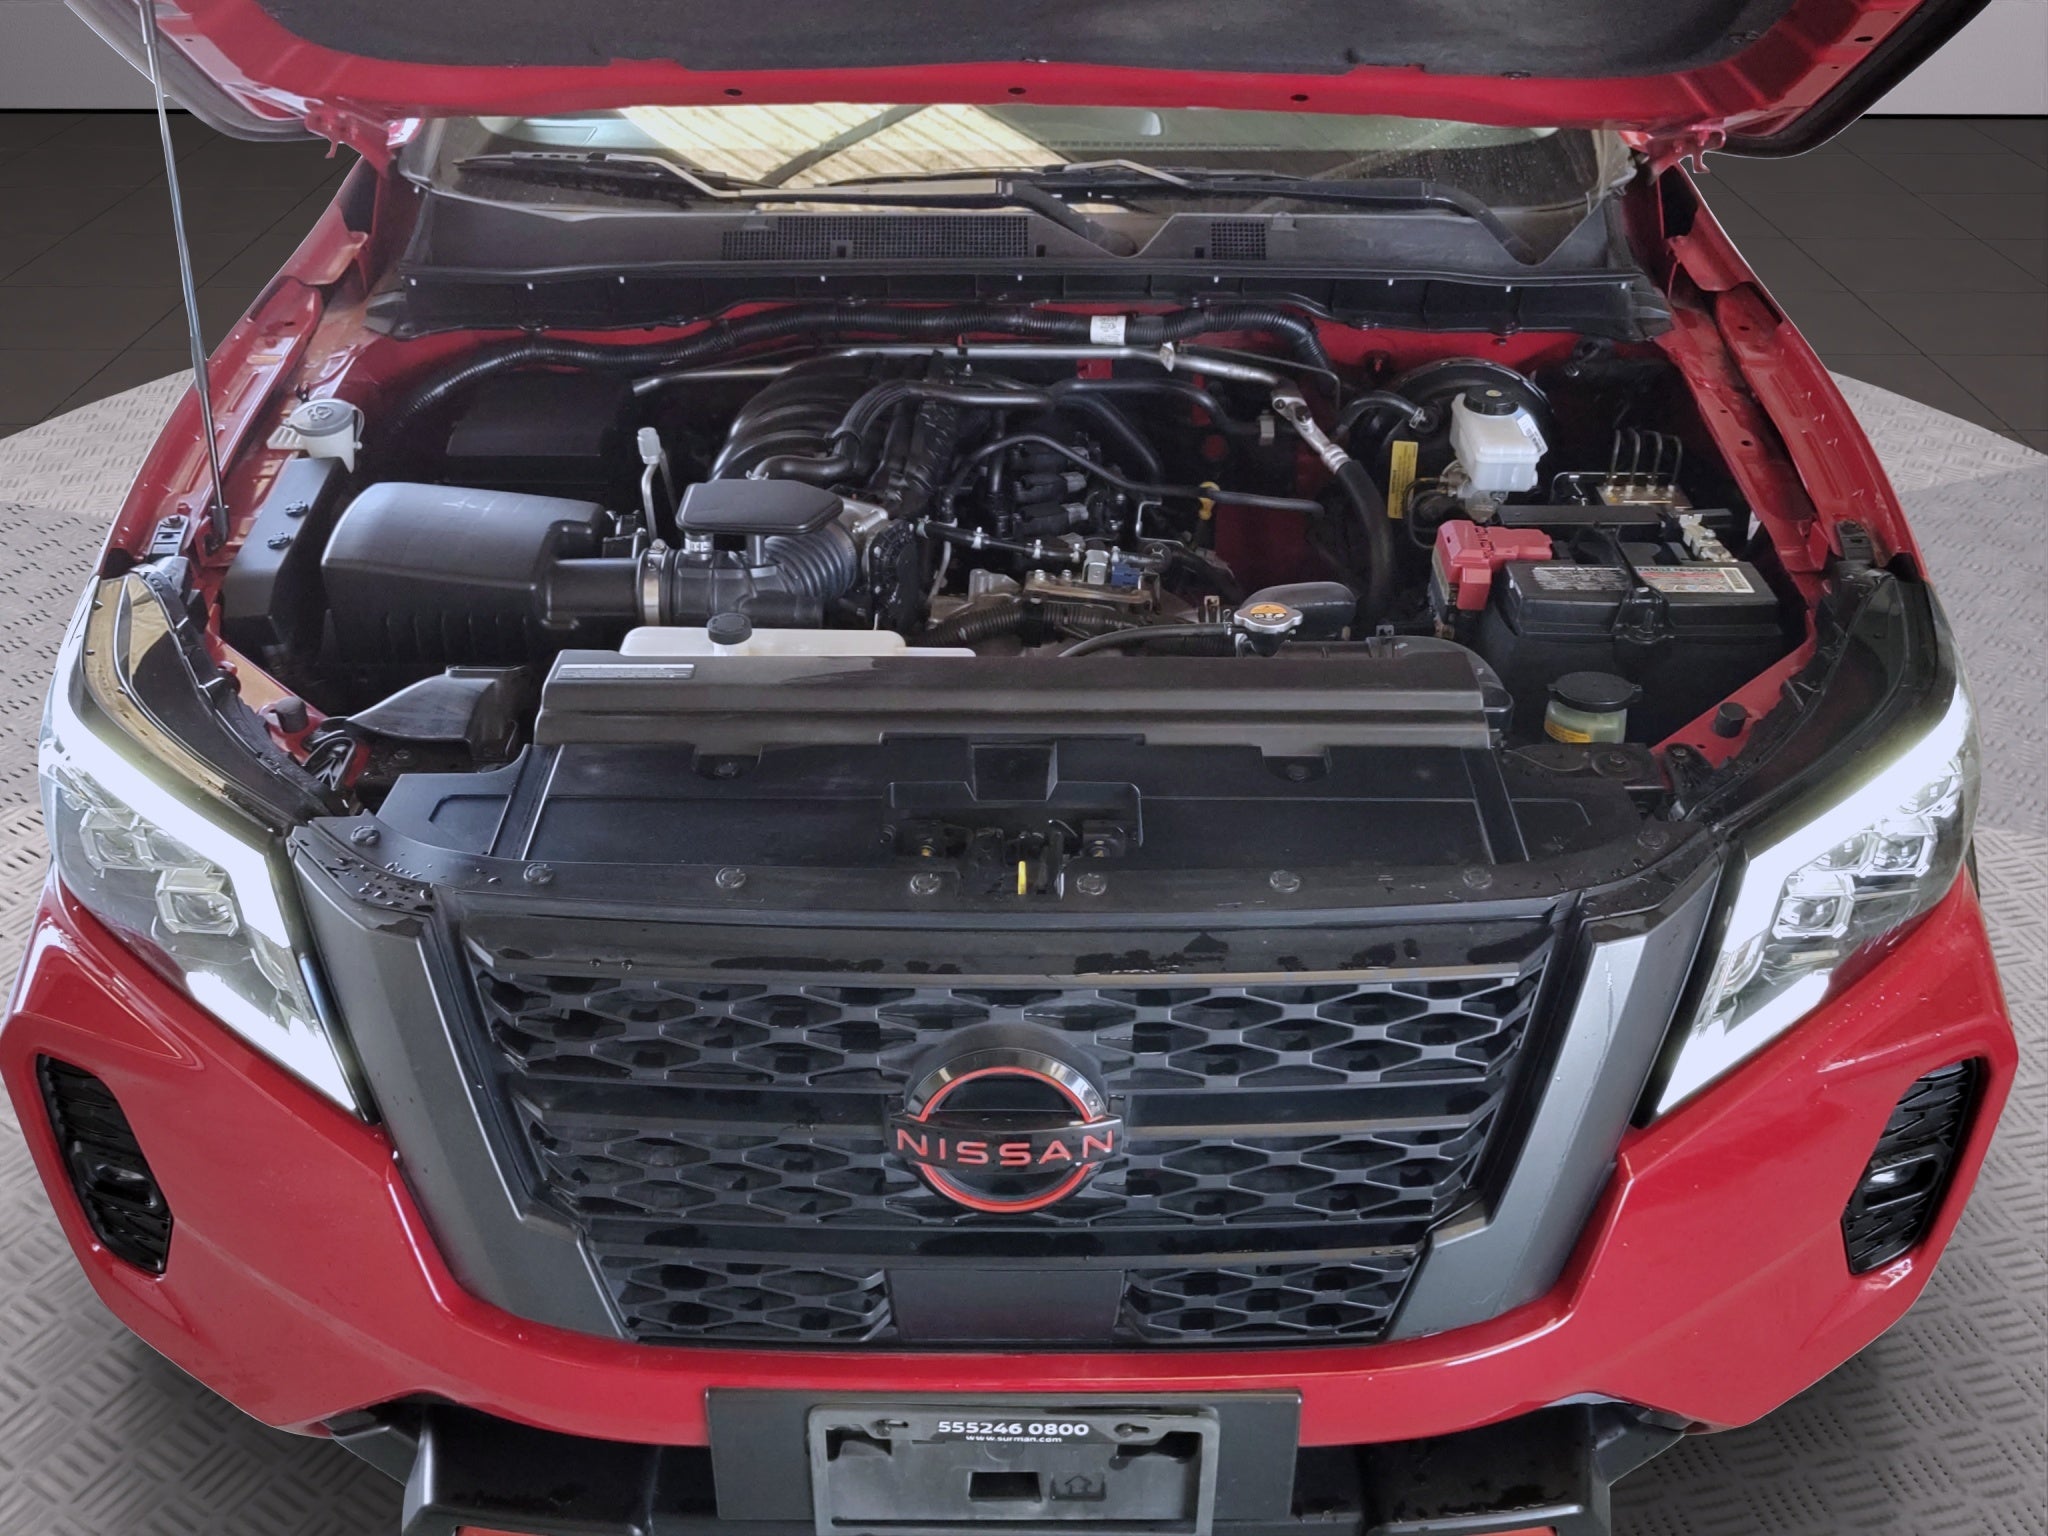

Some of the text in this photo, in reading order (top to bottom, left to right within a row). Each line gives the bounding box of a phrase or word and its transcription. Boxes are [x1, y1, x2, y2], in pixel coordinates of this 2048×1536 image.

[897, 1129, 1113, 1166] NISSAN
[1028, 1423, 1089, 1436] 0800
[966, 1435, 1062, 1443] www.surman.com
